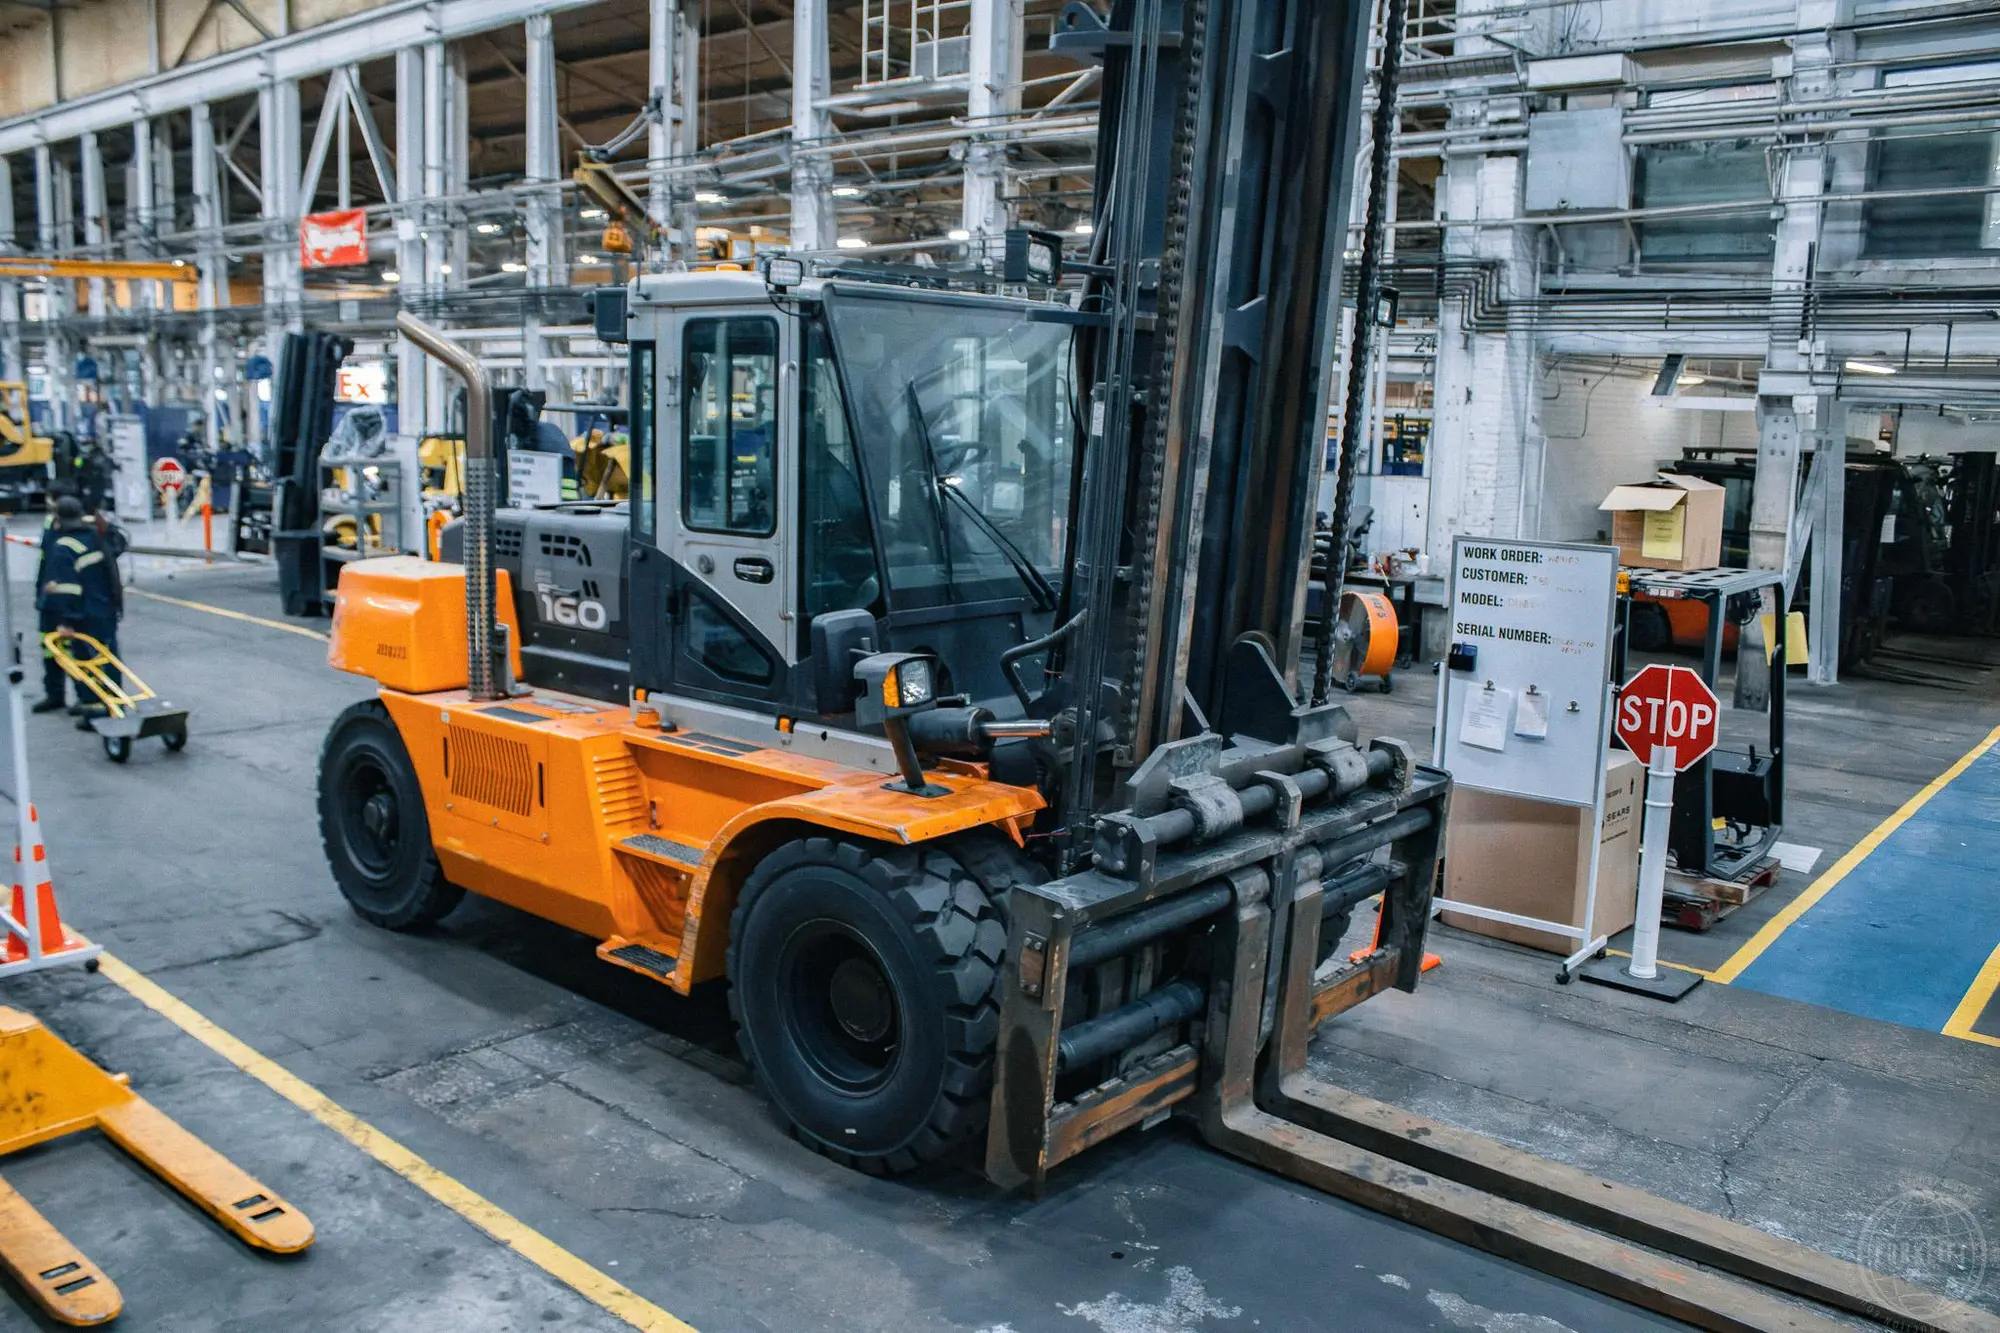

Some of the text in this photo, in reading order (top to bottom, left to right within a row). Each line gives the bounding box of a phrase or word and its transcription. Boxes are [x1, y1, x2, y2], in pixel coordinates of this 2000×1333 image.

[1464, 546, 1497, 560] WORK
[1501, 549, 1543, 563] ORDER:
[1462, 567, 1528, 585] CUSTOMER:
[1461, 592, 1503, 607] MODEL:
[541, 593, 606, 630] 160
[1457, 622, 1495, 638] SERIAL
[1498, 627, 1551, 644] NUMBER:
[1621, 694, 1713, 740] STOP
[1606, 805, 1631, 822] SEARS
